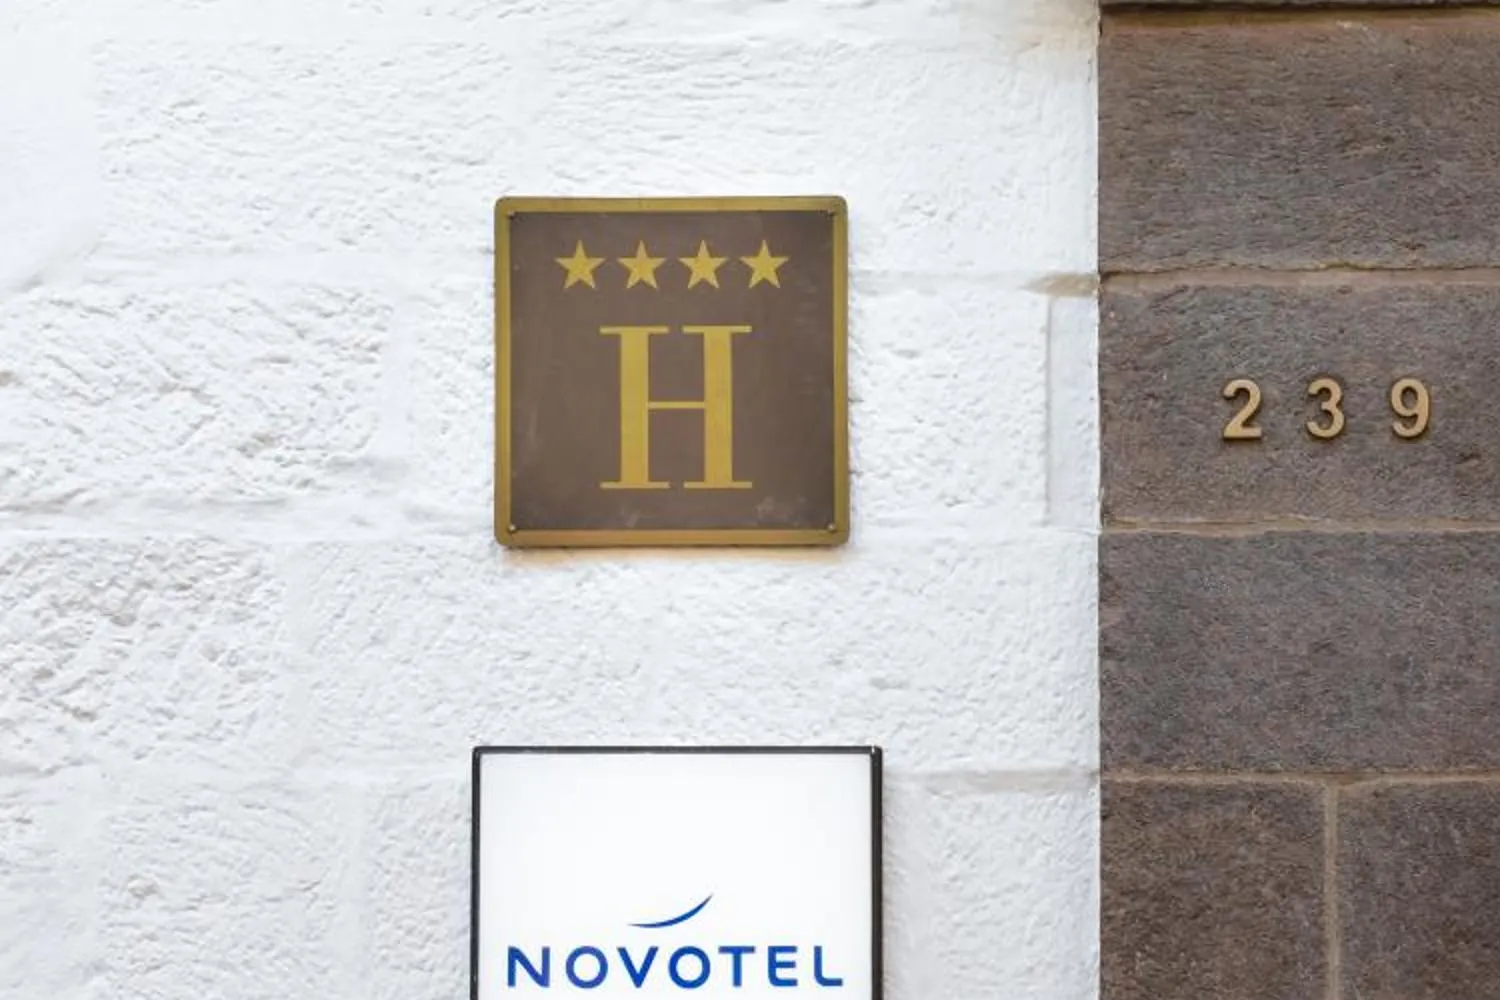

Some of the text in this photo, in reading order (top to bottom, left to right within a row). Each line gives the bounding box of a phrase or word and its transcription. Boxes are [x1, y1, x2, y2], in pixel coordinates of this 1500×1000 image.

[599, 325, 753, 489] H
[1222, 377, 1430, 438] 239
[506, 944, 844, 989] NOVOTEL
